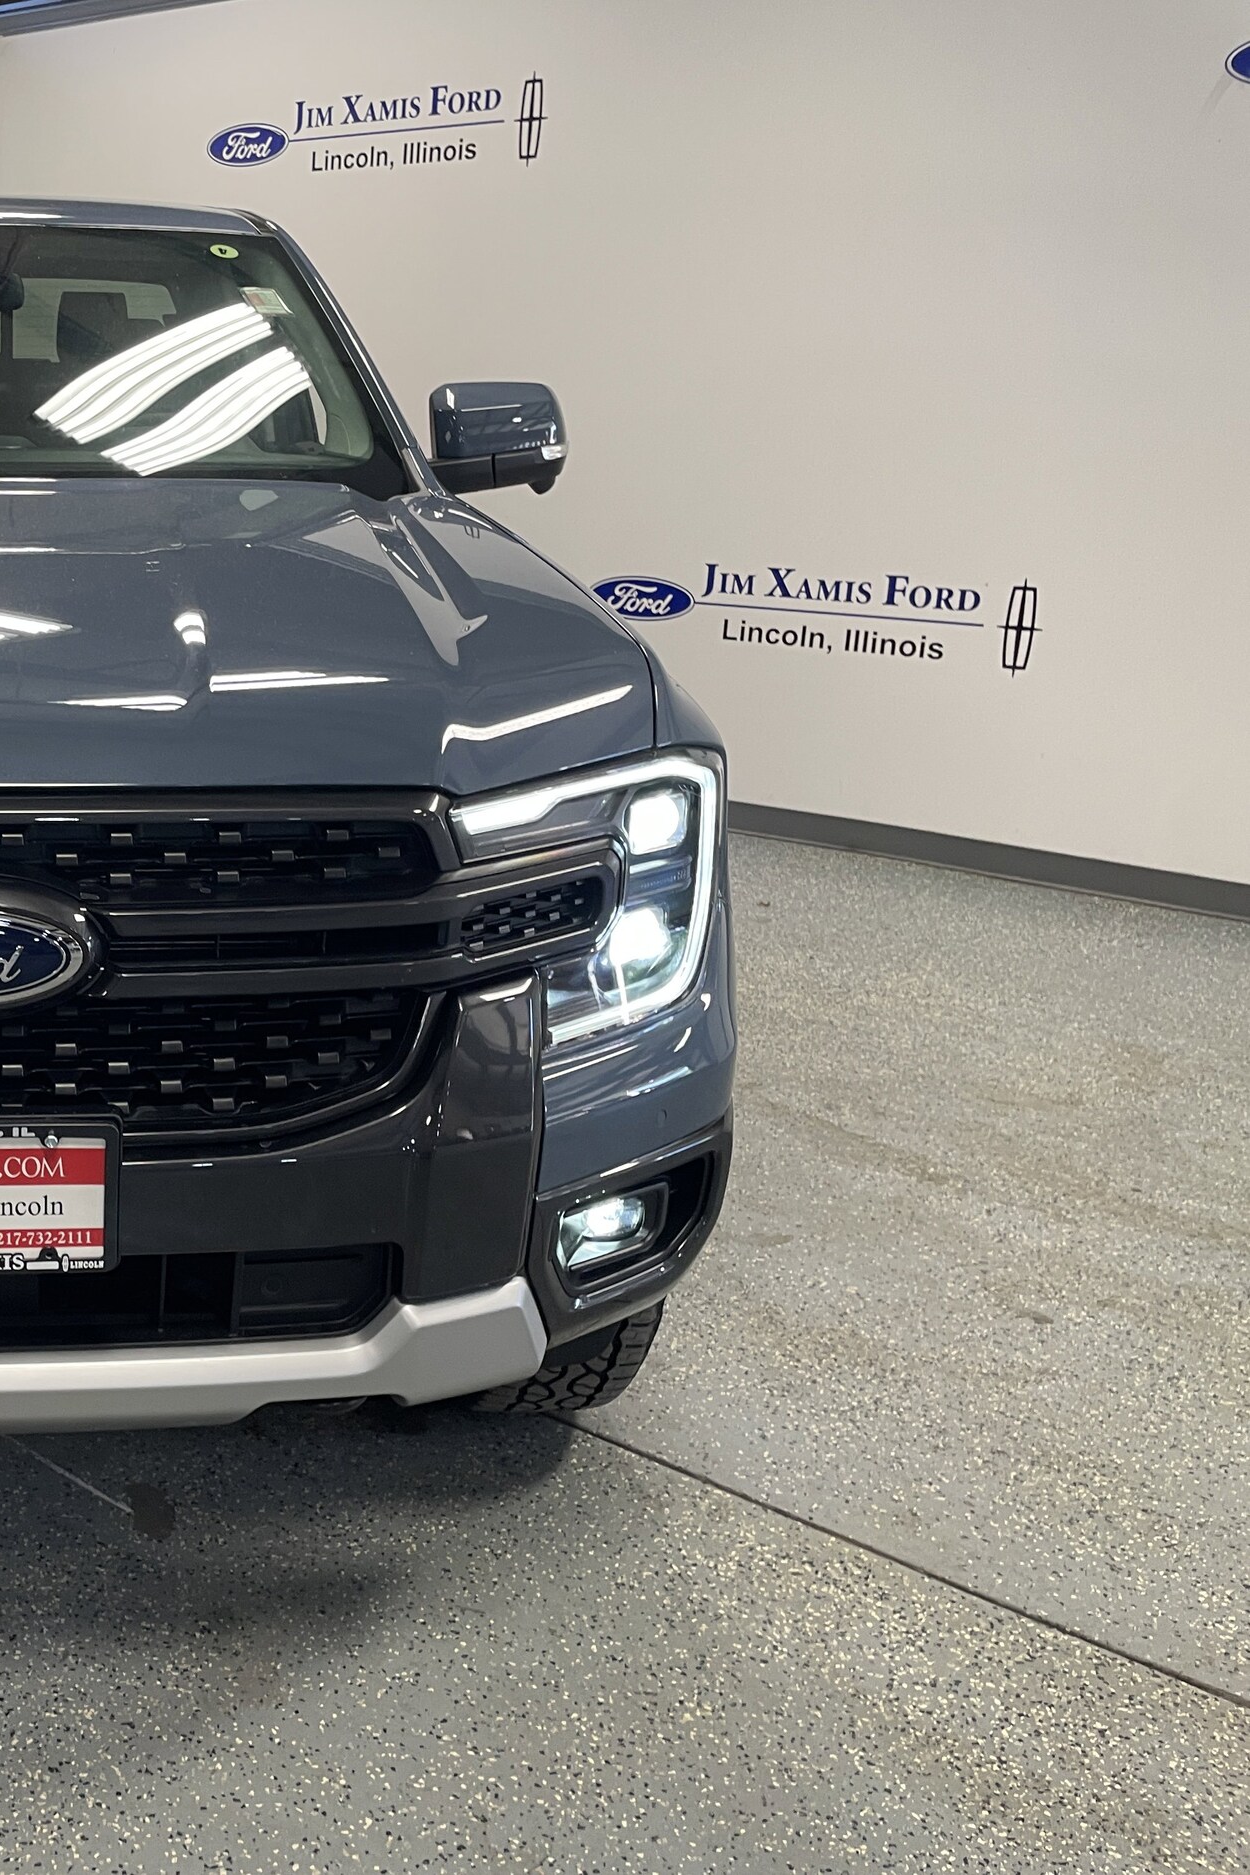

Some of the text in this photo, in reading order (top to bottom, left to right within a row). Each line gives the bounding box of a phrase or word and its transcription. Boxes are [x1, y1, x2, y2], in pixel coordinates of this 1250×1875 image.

[293, 85, 501, 134] JIM XAMIS FORD
[222, 132, 271, 160] Ford
[312, 138, 477, 172] Lincoln, Illinois
[607, 583, 673, 615] Ford
[702, 563, 981, 612] JIM XAMIS FORD
[722, 619, 945, 660] Lincoln, Illinois
[12, 1126, 36, 1138] IL
[70, 1260, 104, 1269] LINCOLN
